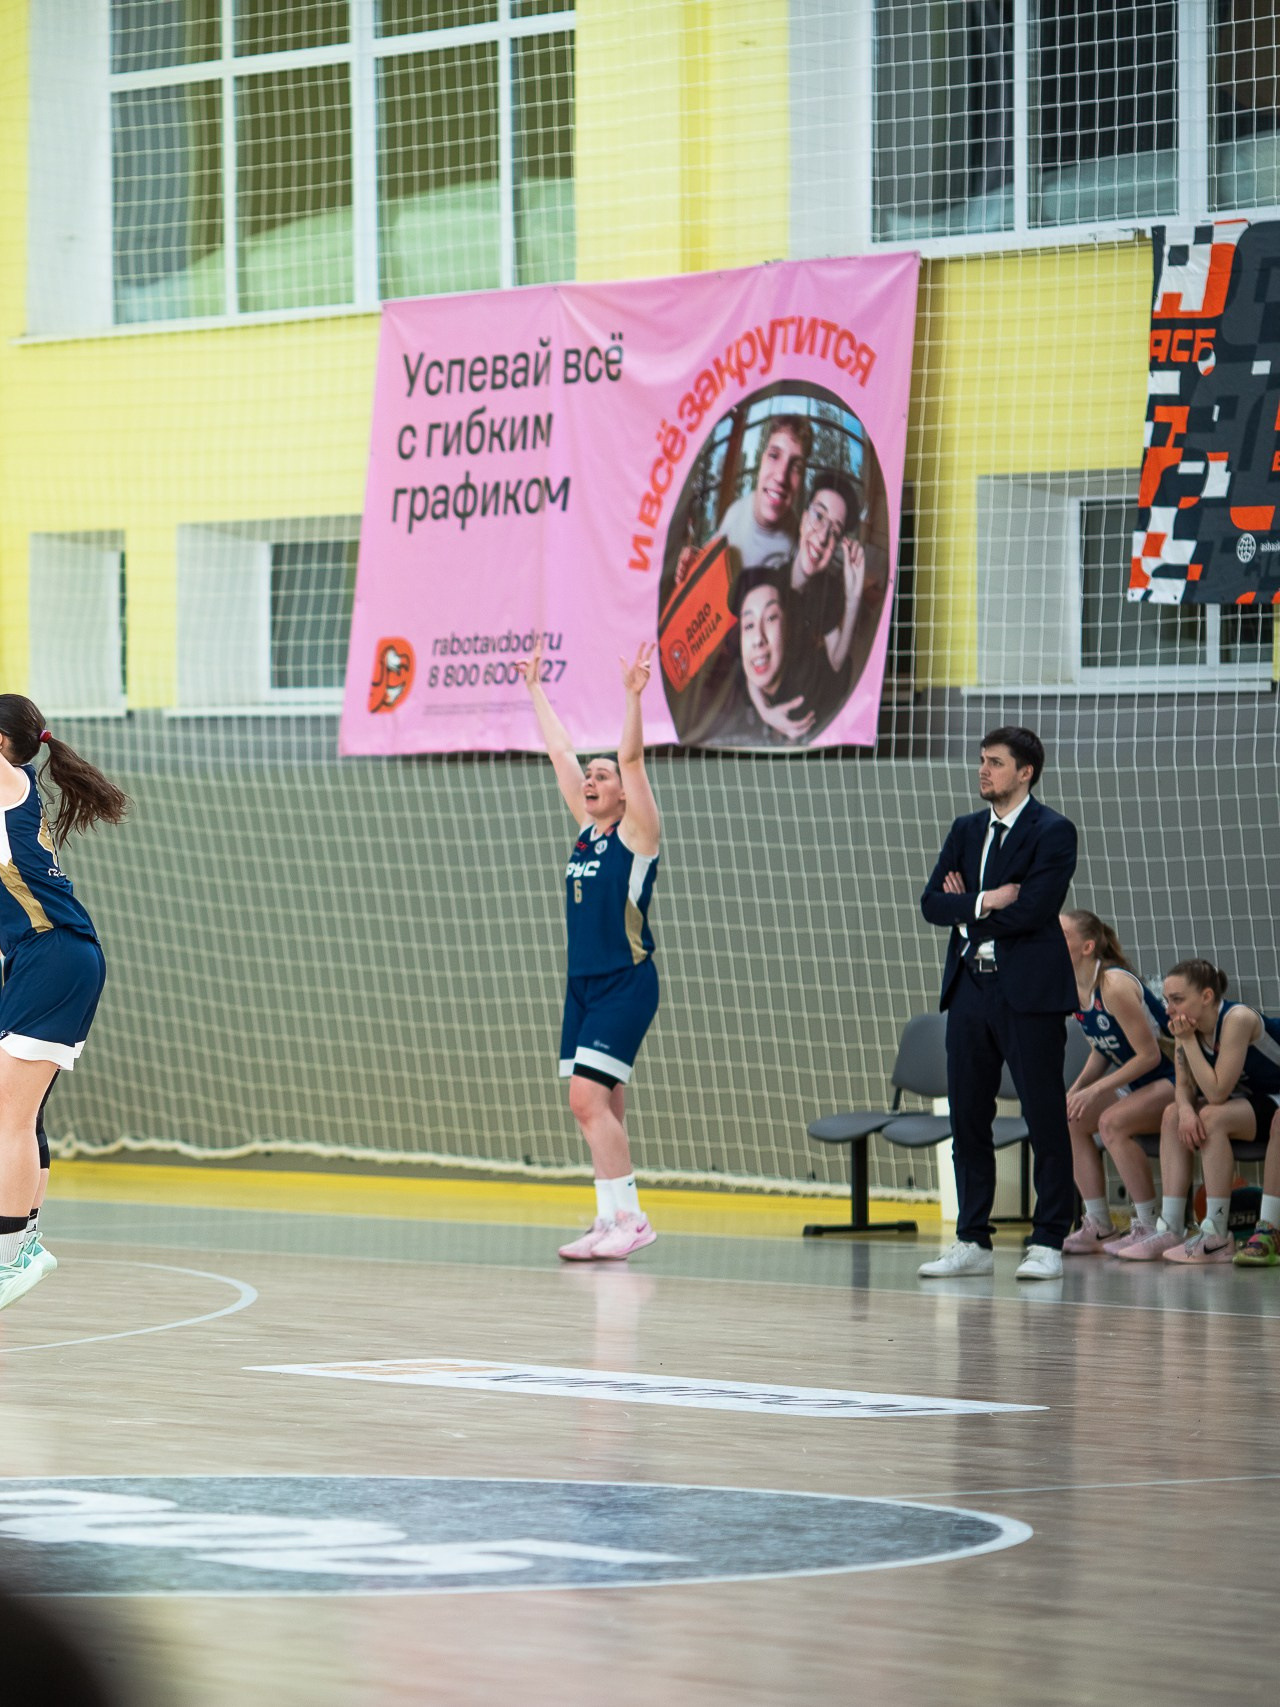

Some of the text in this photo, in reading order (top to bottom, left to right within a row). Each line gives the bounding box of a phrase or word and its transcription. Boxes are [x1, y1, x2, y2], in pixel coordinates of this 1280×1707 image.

[403, 332, 624, 398] Успевай всё
[397, 405, 554, 460] с гибким
[628, 315, 878, 572] и всё закрутится
[392, 470, 571, 534] графиком
[686, 602, 712, 642] ДОДО
[573, 879, 583, 904] 6
[457, 1374, 953, 1413] ХИМПРОМ
